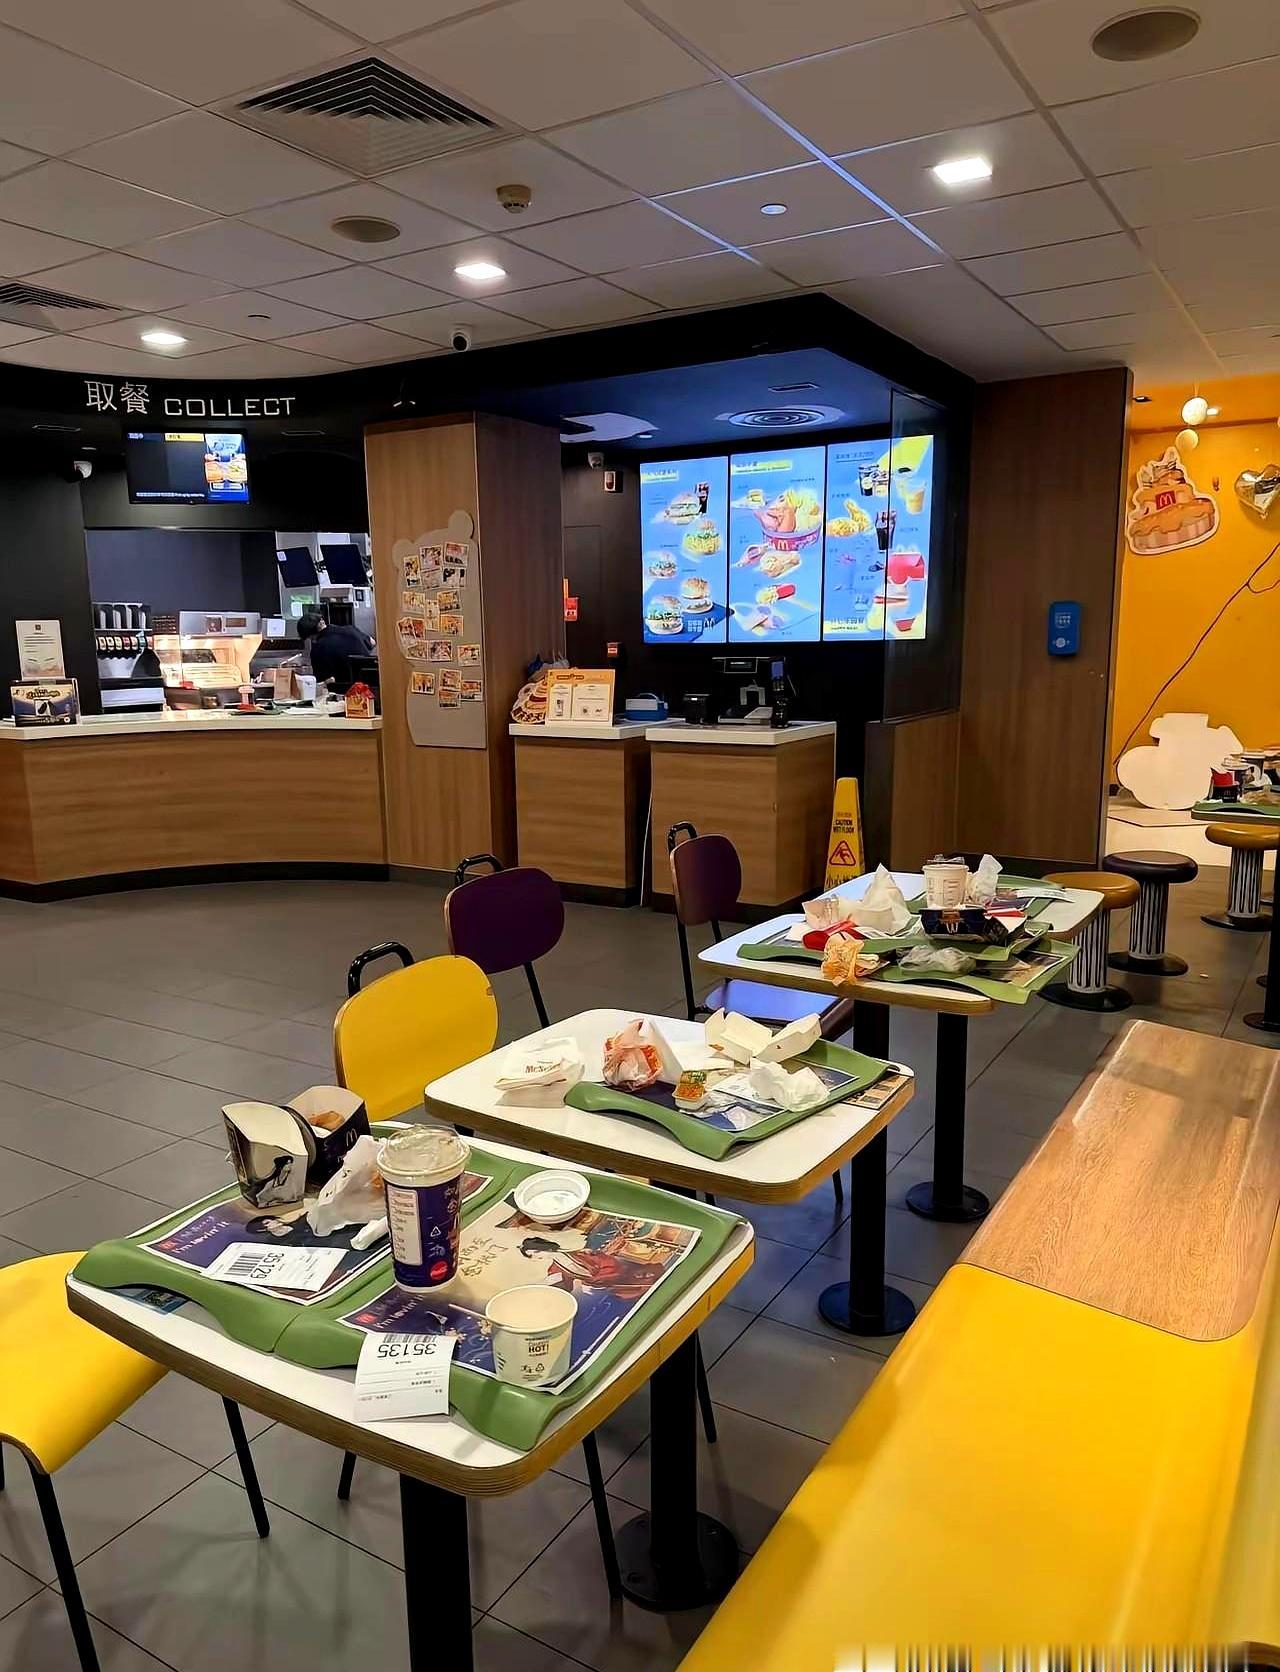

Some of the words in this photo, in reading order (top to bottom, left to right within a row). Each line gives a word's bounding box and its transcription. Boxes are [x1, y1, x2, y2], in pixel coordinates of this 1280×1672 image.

[84, 380, 150, 415] 取餐
[164, 397, 296, 417] COLLECT
[250, 1252, 285, 1279] 35129
[377, 1342, 437, 1359] 35135
